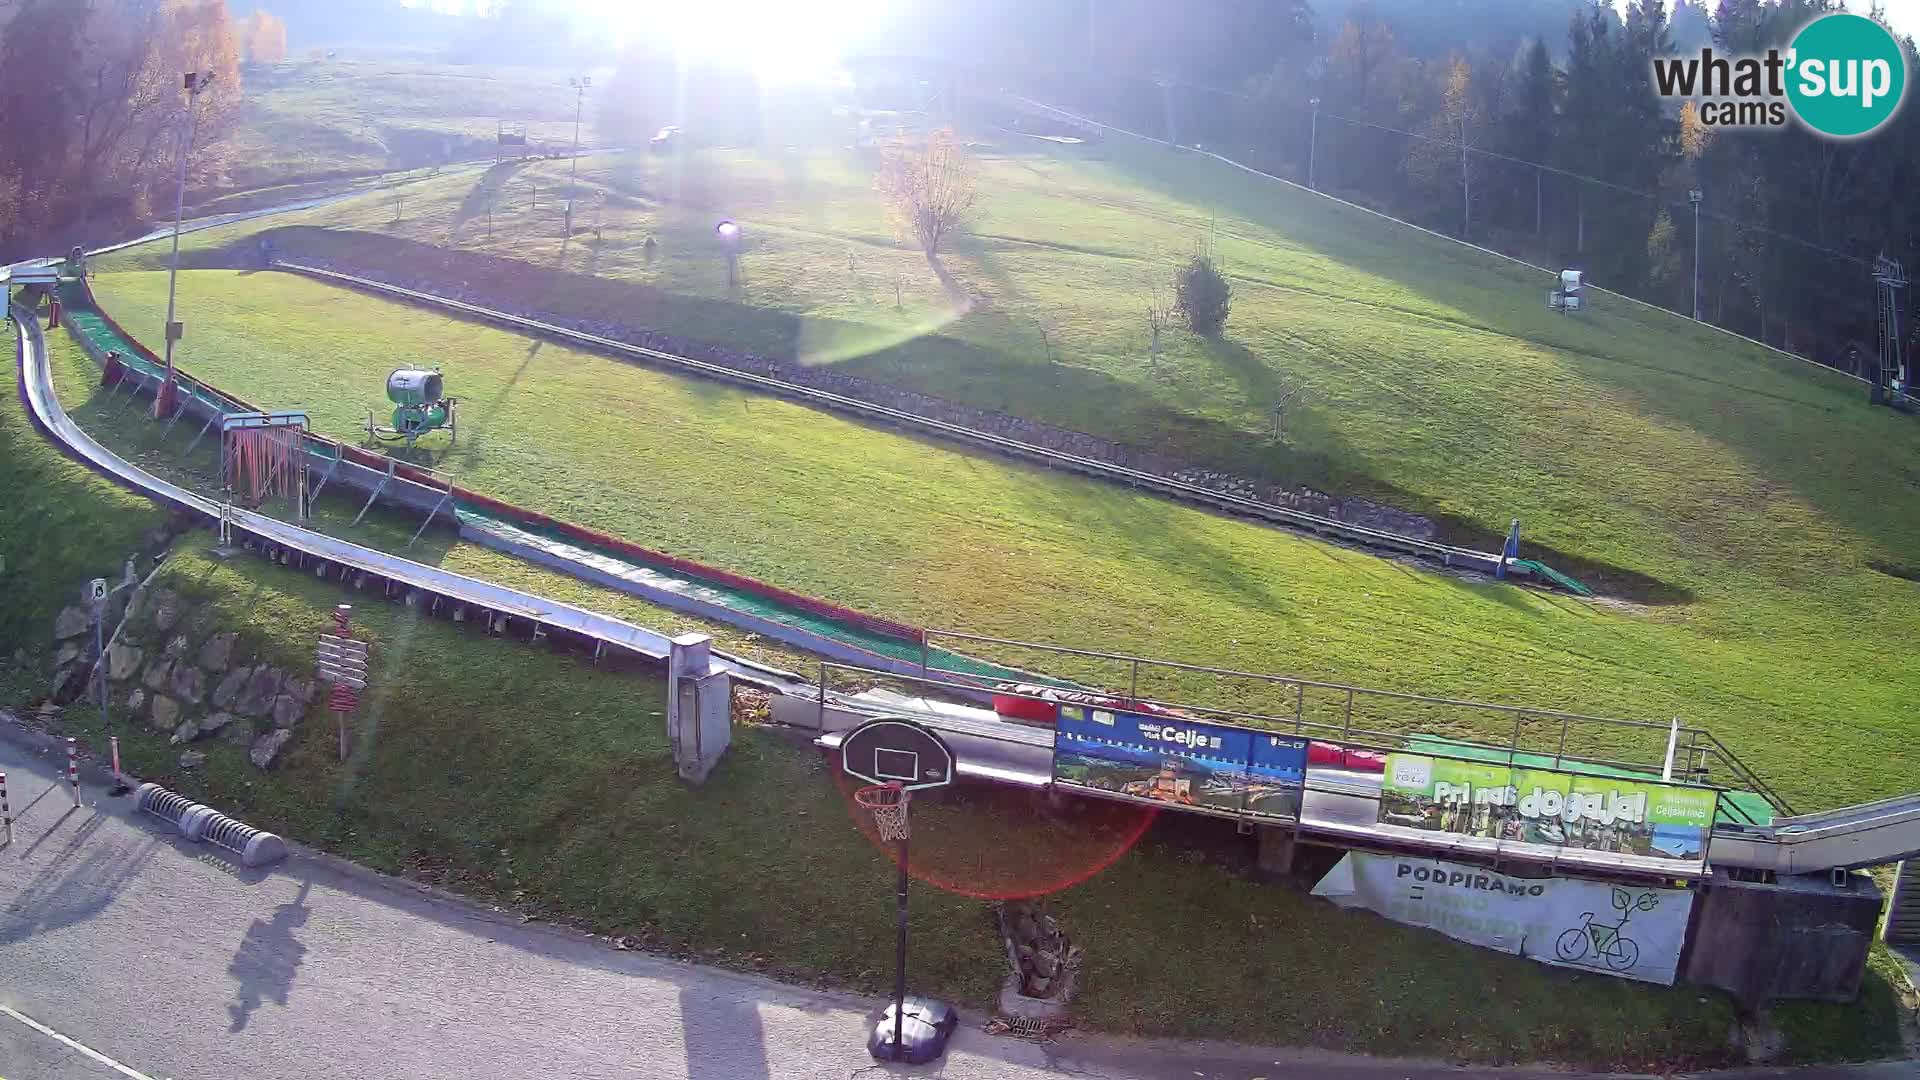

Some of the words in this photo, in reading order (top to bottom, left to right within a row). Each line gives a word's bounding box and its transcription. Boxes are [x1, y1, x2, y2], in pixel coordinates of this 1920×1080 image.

[1161, 726, 1208, 749] Celje
[1518, 786, 1648, 824] dogaja!
[1397, 863, 1545, 897] PODPIRAMO
